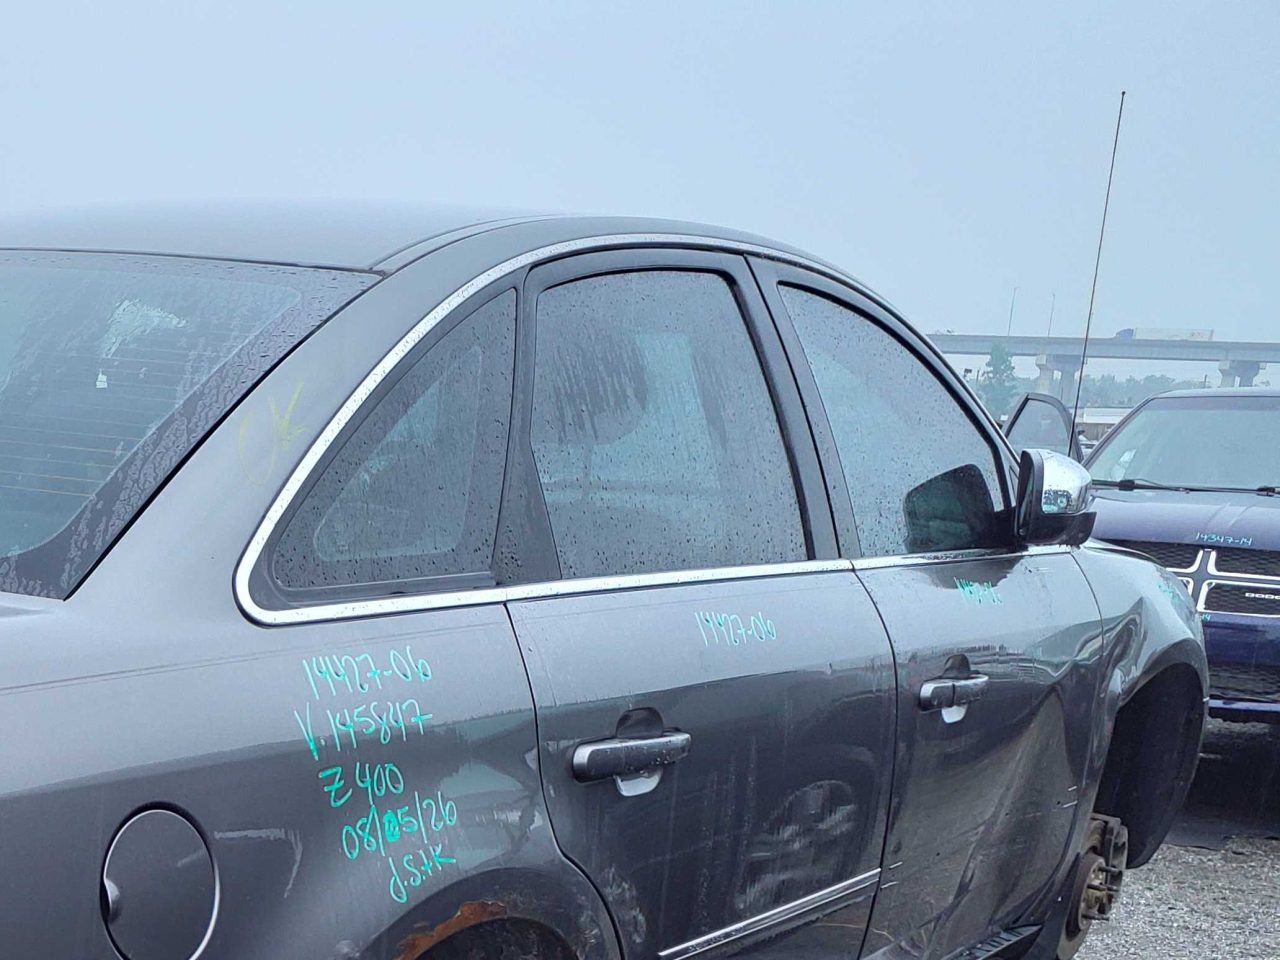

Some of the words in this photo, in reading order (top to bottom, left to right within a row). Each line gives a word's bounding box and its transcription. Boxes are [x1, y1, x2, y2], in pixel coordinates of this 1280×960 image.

[694, 611, 777, 648] 14427-06
[302, 645, 433, 701] 14427-06
[354, 761, 405, 806] 400
